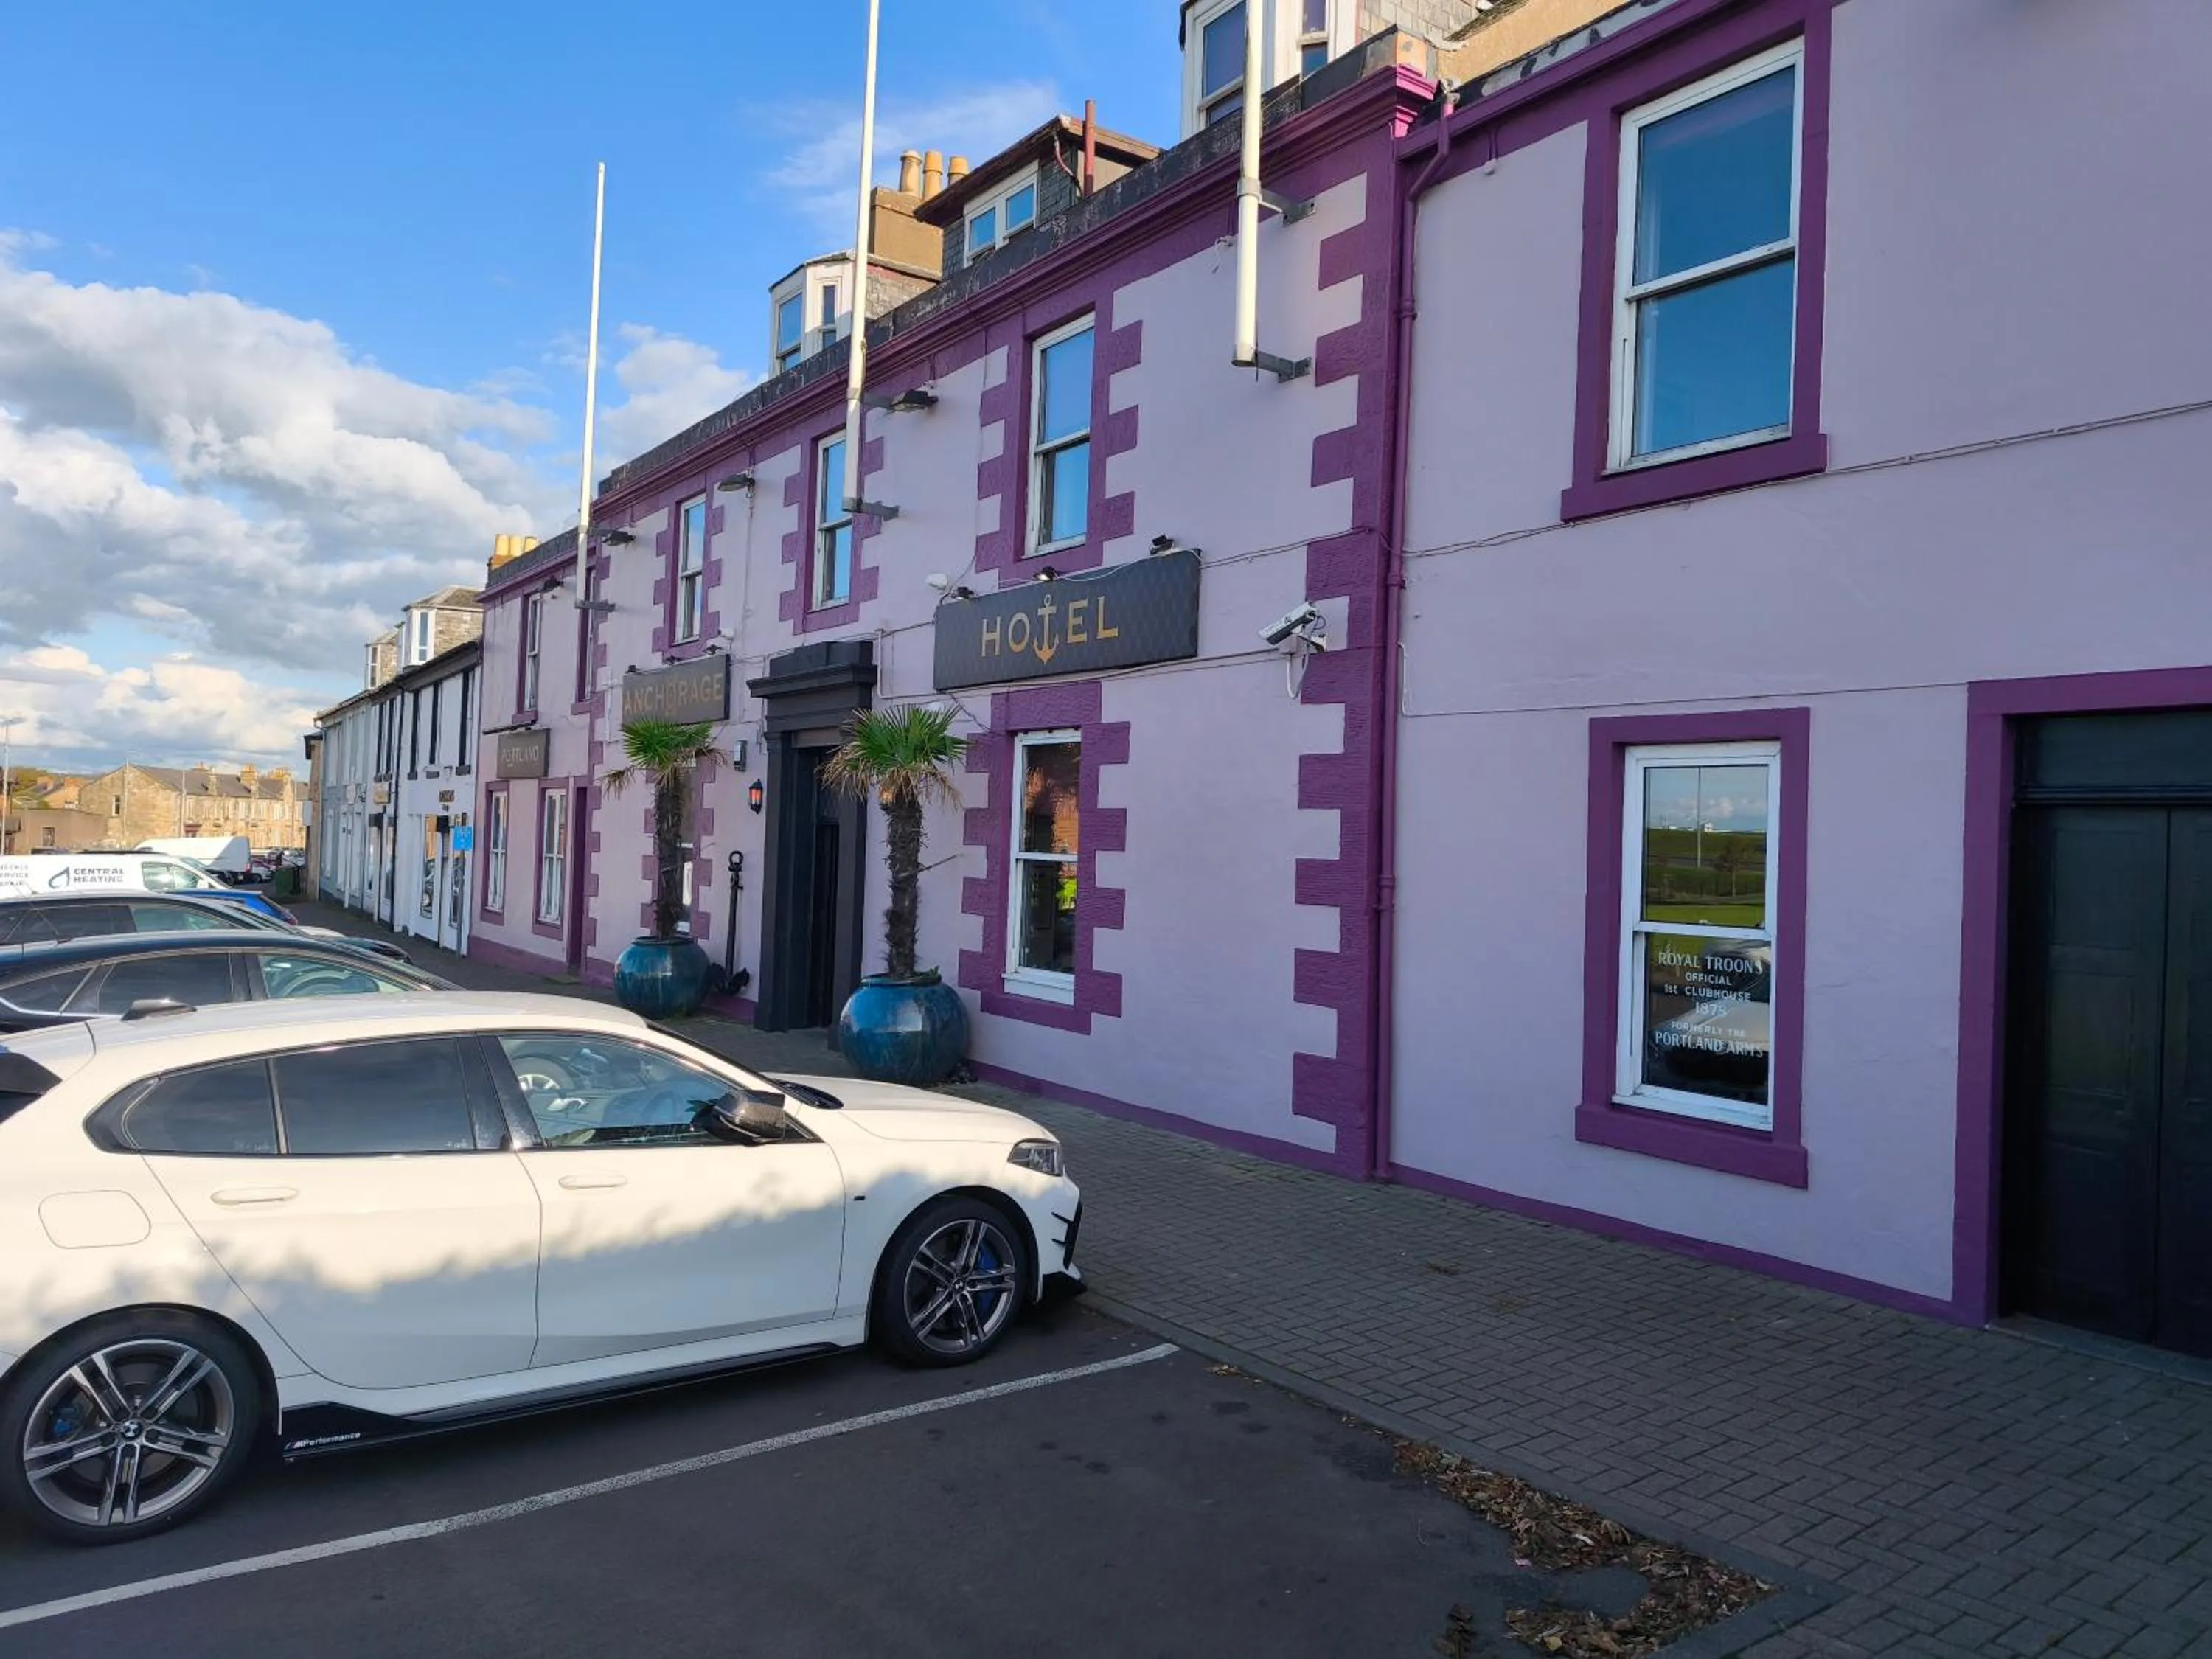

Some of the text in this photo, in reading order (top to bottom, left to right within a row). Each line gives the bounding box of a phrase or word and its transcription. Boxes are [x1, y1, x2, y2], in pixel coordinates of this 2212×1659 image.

[981, 594, 1119, 665] HOTEL
[624, 672, 723, 717] ANCHORAGE
[1659, 951, 1701, 968] ROYAL
[1685, 973, 1732, 986] OFFICIAL
[1664, 984, 1751, 1003] 1st CLUBHOUSE
[1672, 1021, 1746, 1037] FORMERLY THE
[1655, 1031, 1763, 1058] PORTLAND ARMS
